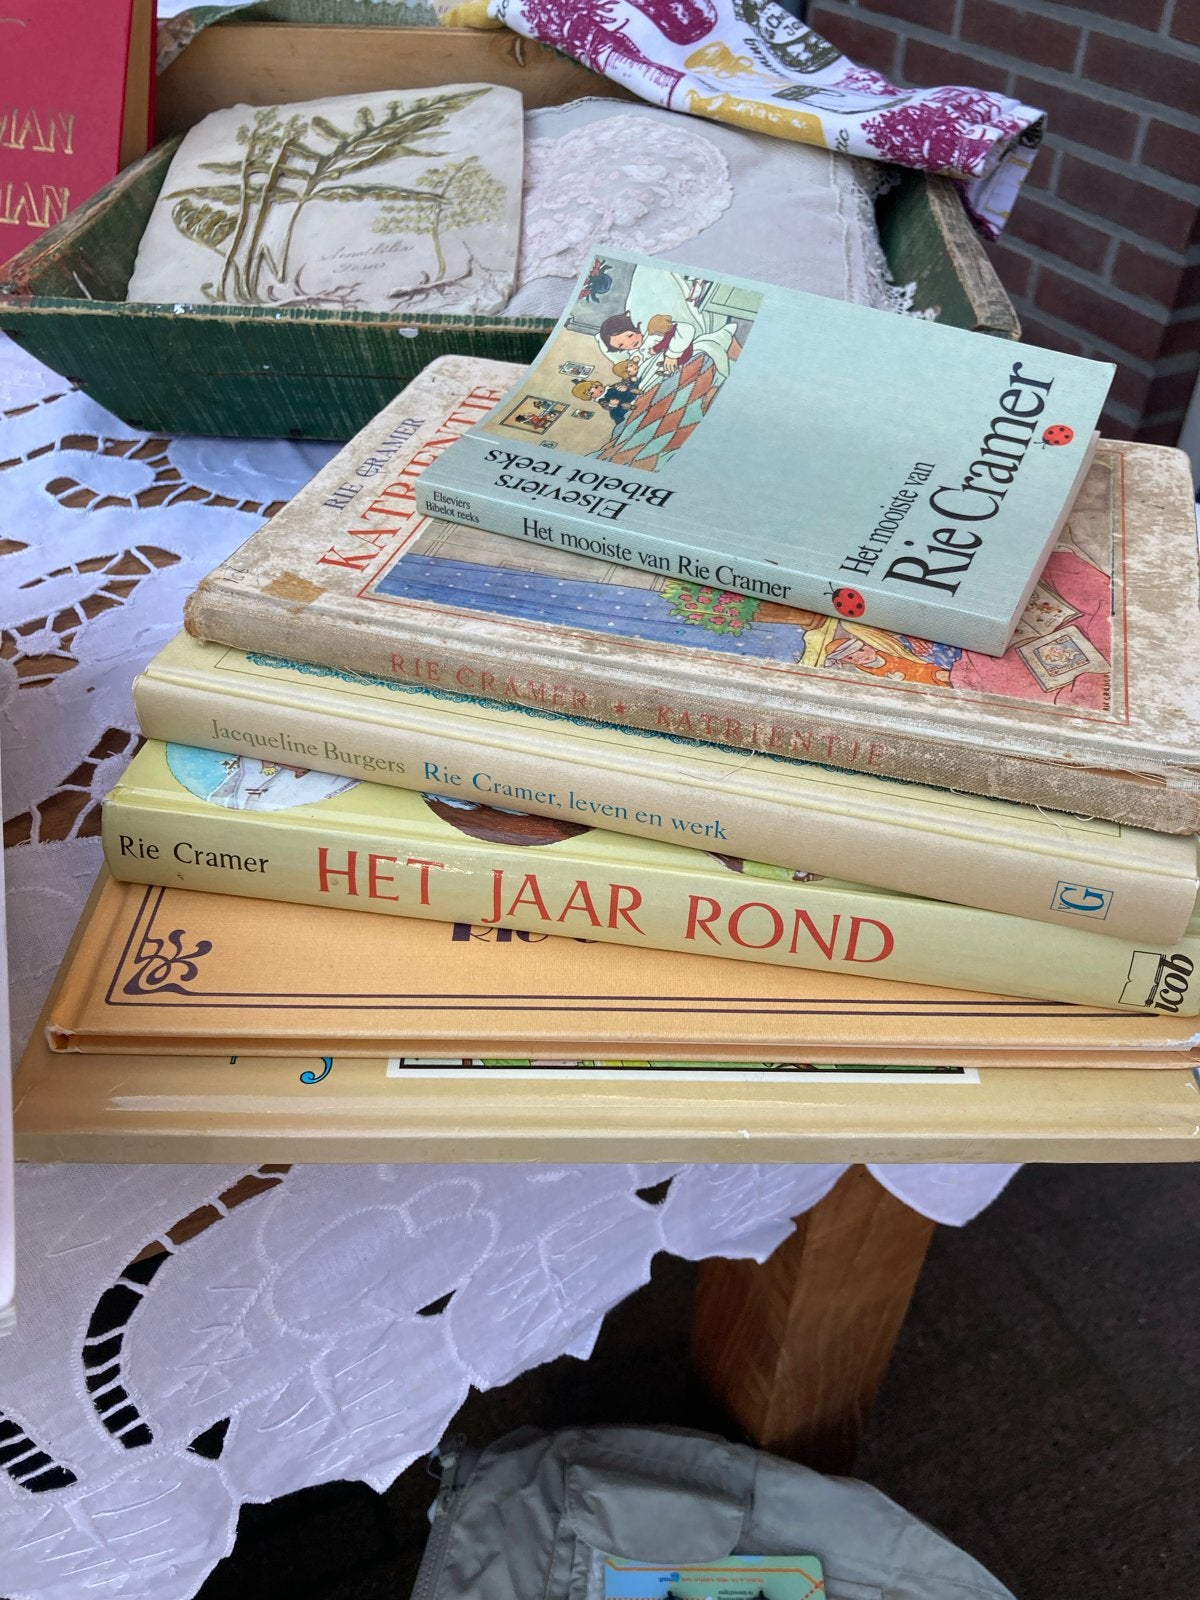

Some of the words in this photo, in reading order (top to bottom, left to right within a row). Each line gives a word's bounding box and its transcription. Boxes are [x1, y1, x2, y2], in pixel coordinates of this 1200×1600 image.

[323, 481, 363, 511] RIE
[355, 416, 426, 478] CRAMER
[484, 449, 563, 476] reeks
[929, 361, 1055, 522] Cramer
[425, 501, 456, 516] Bibelot
[454, 508, 480, 524] reeks
[432, 490, 471, 510] Elseviers
[494, 473, 631, 520] Elseviers
[569, 468, 677, 508] Bibelot
[838, 545, 882, 576] Het
[869, 488, 920, 545] mooiste
[904, 461, 936, 488] van
[522, 517, 555, 542] Het
[560, 531, 632, 562] mooiste
[637, 551, 670, 571] van
[678, 553, 710, 581] Rie
[715, 564, 792, 599] Cramer
[882, 528, 983, 598] Rie
[390, 653, 439, 682] RIE
[456, 666, 590, 710] CRAMER
[656, 706, 887, 768] KATRIENTJE
[210, 719, 318, 757] Jacqueline
[323, 738, 406, 774] Burgers
[423, 760, 462, 787] Rie
[472, 771, 562, 808] Cramer,
[569, 791, 628, 821] leven
[635, 808, 663, 827] en
[671, 816, 728, 842] werk
[119, 834, 160, 861] Rie
[173, 842, 269, 874] Cramer
[317, 847, 445, 905] HET
[481, 869, 646, 936] JAAR
[684, 894, 895, 963] ROND
